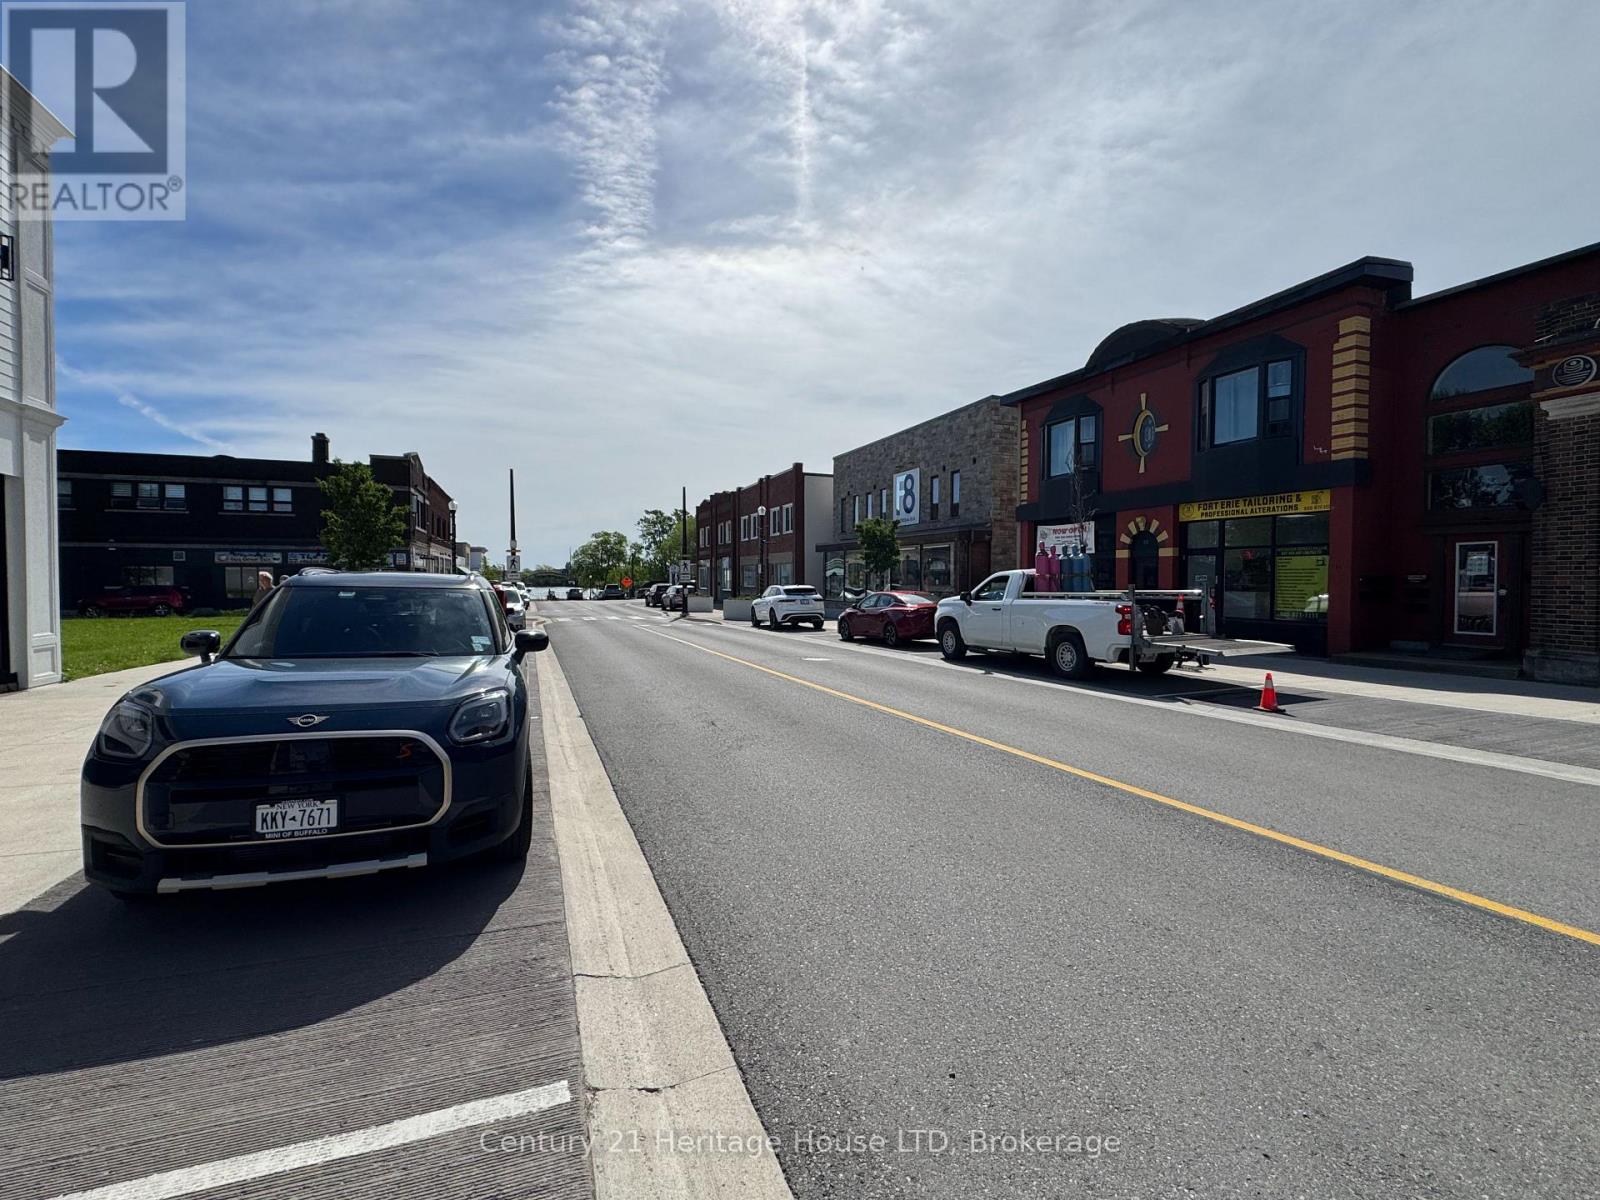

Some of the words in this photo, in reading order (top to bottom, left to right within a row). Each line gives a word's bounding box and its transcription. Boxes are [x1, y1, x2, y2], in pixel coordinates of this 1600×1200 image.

[1197, 501, 1219, 512] FORT
[1221, 500, 1240, 509] ERIE
[1243, 494, 1293, 507] TAILORING
[1200, 508, 1248, 518] PROFESSIONAL
[1250, 504, 1299, 514] ALTERATIONS
[276, 802, 295, 810] NEW
[296, 801, 319, 809] YORK
[293, 828, 328, 837] BUFFALO
